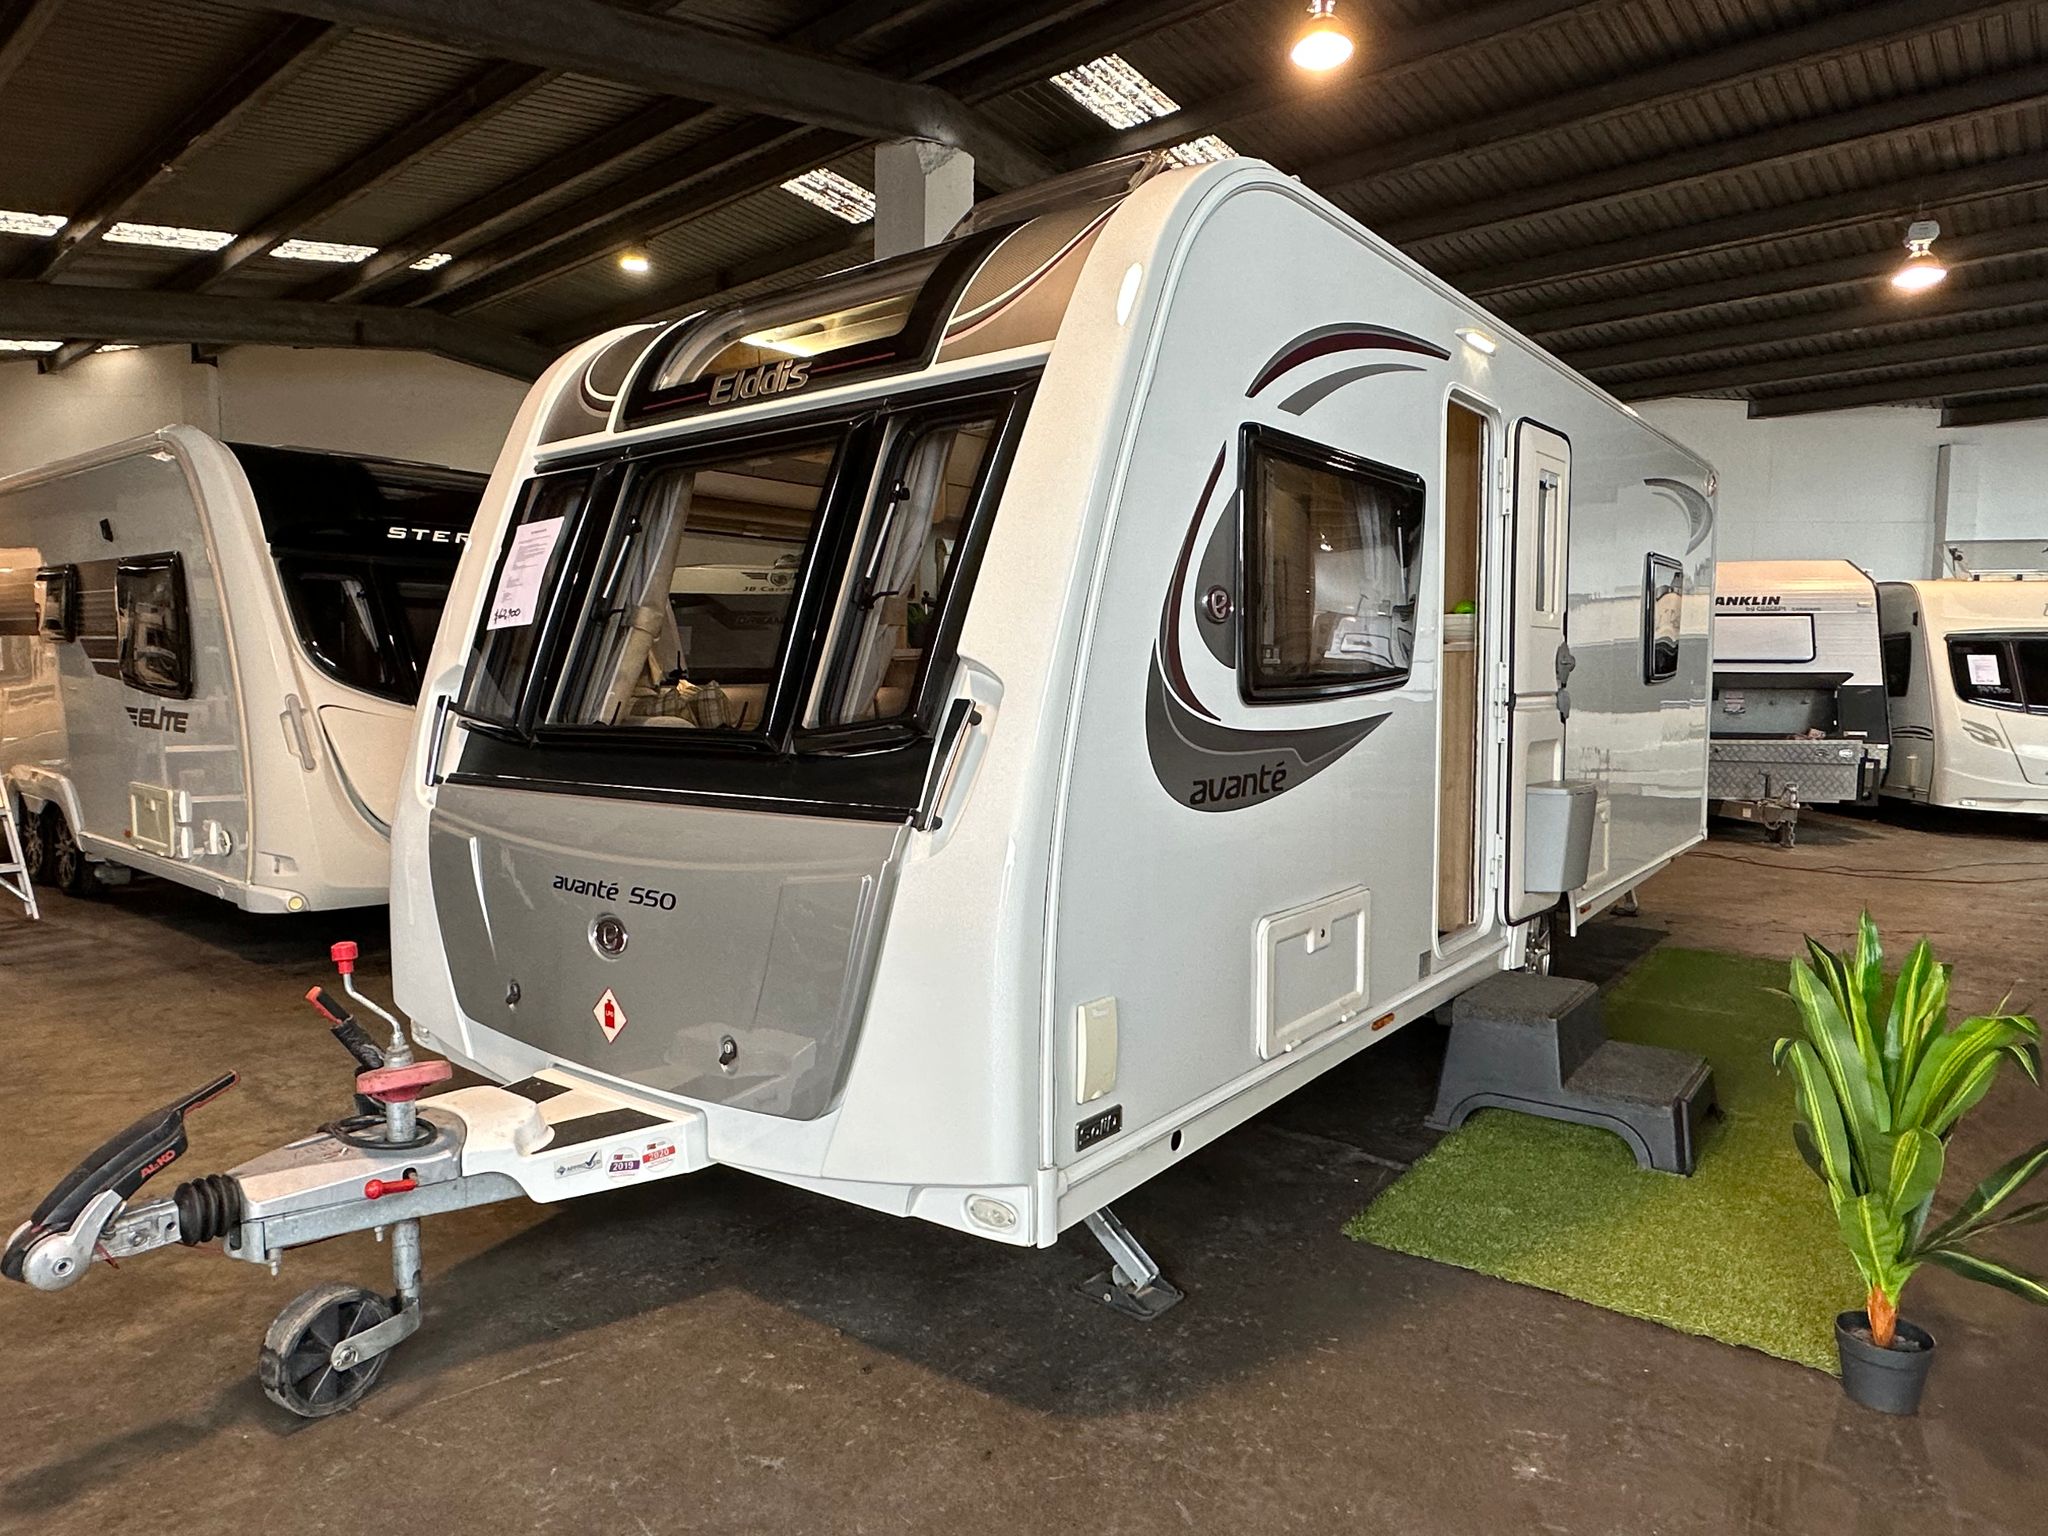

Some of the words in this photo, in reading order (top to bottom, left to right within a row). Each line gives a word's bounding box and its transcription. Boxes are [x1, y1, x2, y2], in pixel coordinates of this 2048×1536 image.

[709, 359, 813, 406] Elddis
[1715, 596, 1781, 606] ANKLIN
[137, 706, 189, 734] ELITE
[1189, 761, 1287, 805] avanté
[553, 875, 619, 901] avanté
[612, 1161, 634, 1171] 2019
[648, 1149, 670, 1161] 2020
